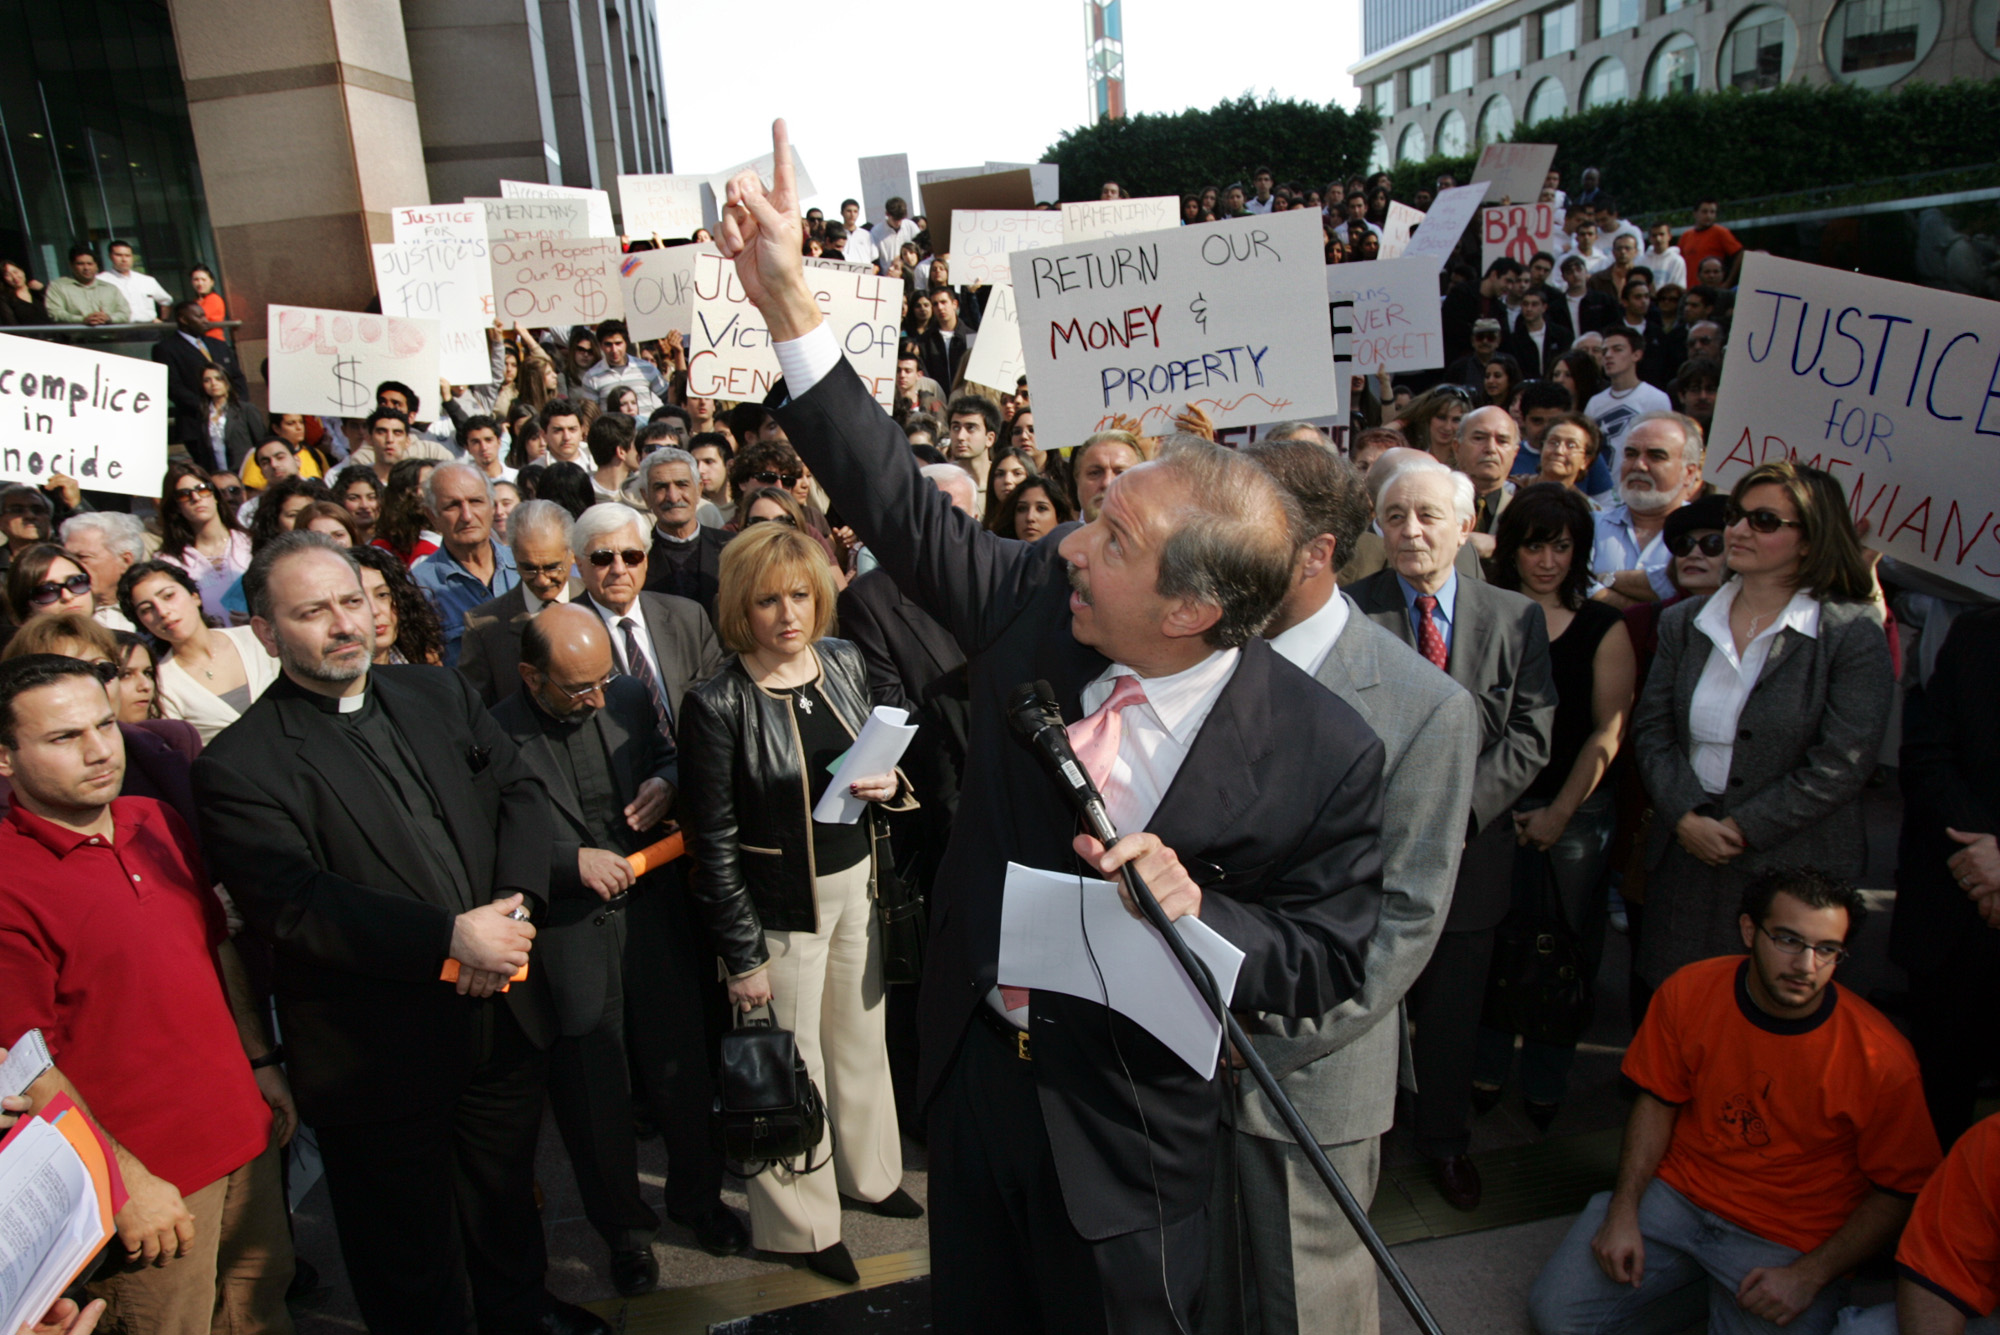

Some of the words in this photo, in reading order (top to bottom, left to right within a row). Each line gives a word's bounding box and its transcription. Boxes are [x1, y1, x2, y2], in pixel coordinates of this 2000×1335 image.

[401, 209, 476, 226] JUSTICE
[484, 200, 577, 228] RMENIANS
[1069, 201, 1166, 232] ARMENIANS
[551, 259, 606, 281] Blood
[1031, 243, 1160, 298] RETURN
[1201, 229, 1281, 266] OUR
[632, 268, 694, 316] OUR
[273, 309, 427, 359] BLOOD
[1050, 303, 1162, 359] MONEY
[1189, 291, 1208, 335] &
[1101, 344, 1268, 408] PROPERTY
[23, 405, 53, 435] in
